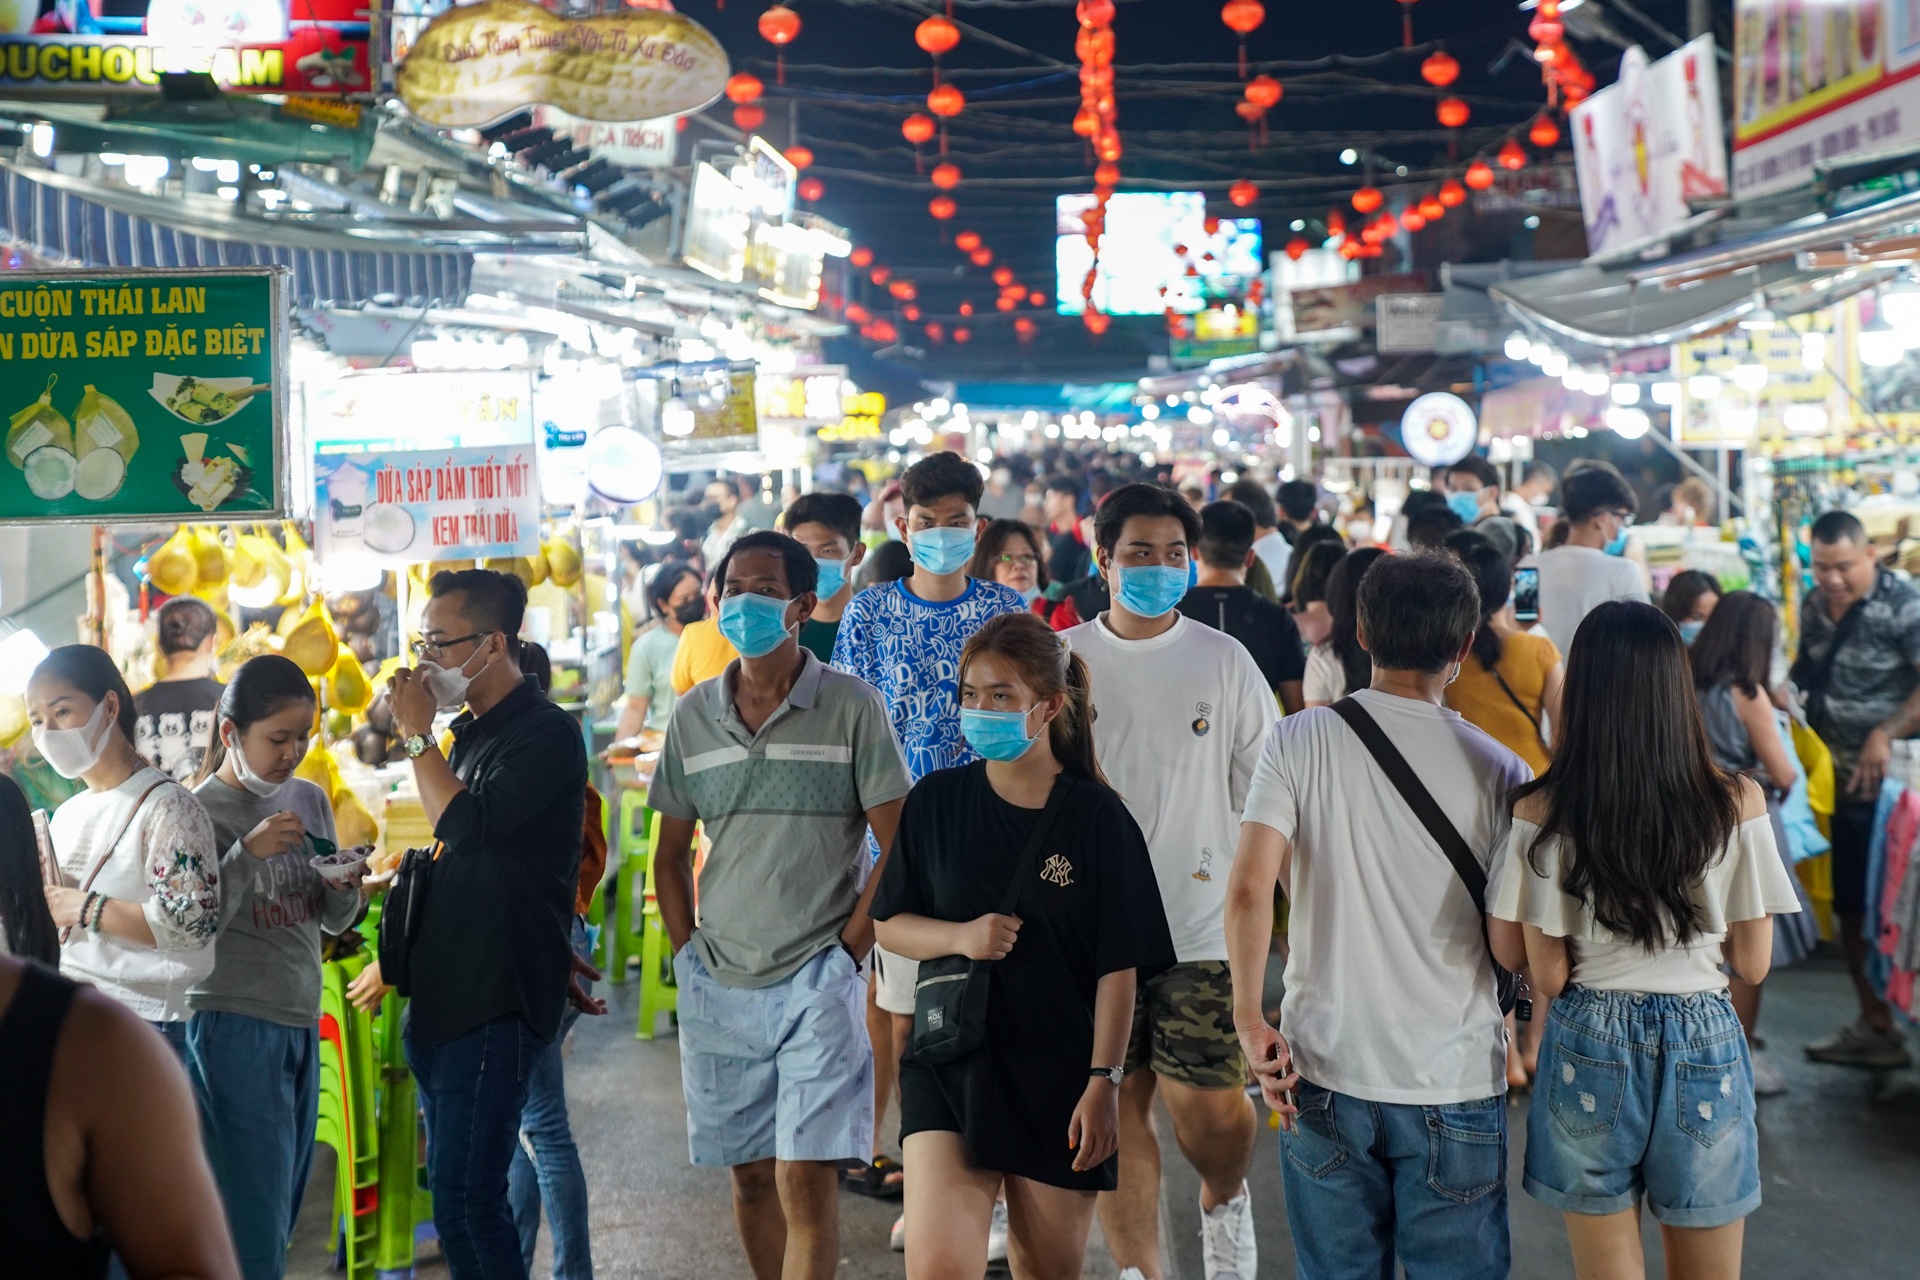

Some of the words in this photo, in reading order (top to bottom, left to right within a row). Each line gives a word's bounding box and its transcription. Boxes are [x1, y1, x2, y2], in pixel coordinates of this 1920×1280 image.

[0, 284, 73, 323] CUỘN
[79, 283, 144, 317] THÁI
[151, 286, 206, 315] LAN
[21, 326, 78, 360] DỪA
[85, 325, 138, 358] SÁP
[144, 323, 197, 361] ĐẶC
[204, 322, 265, 360] BIỆT
[375, 462, 404, 505] DỪA
[406, 462, 433, 504] SÁP
[469, 454, 502, 501] THỐT
[505, 453, 529, 498] NỐT
[432, 515, 460, 546] KEM
[463, 508, 492, 545] TRÁI
[494, 507, 519, 543] DỪA
